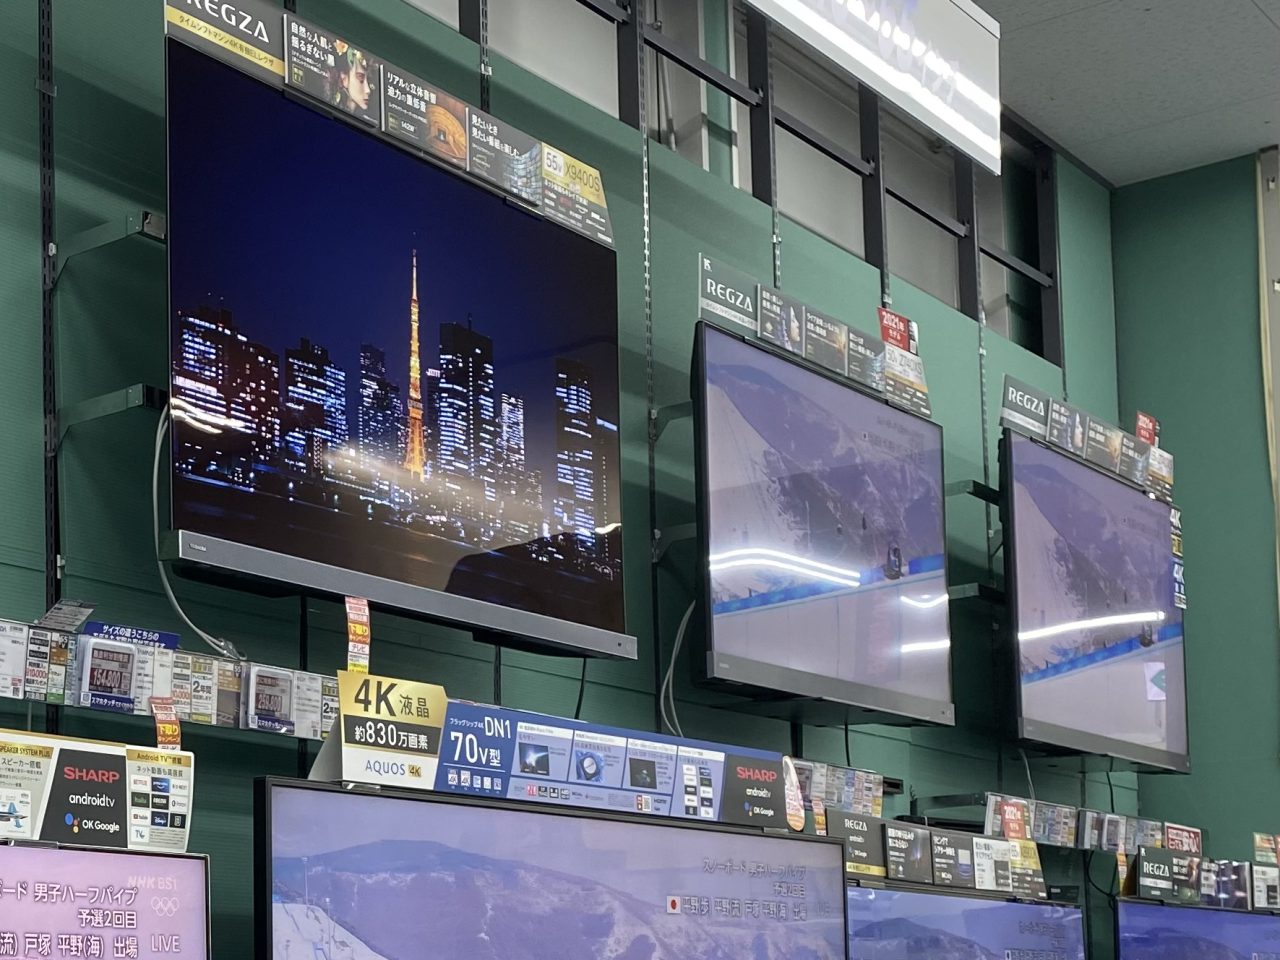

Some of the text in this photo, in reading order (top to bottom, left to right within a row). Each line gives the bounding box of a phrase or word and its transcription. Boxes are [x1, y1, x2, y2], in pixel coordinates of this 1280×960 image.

[291, 22, 333, 51] 自然な人肌と
[472, 114, 498, 136] 見たいとき
[706, 278, 753, 313] REGZA
[882, 311, 905, 333] 2021年
[1008, 386, 1045, 417] REGZA
[103, 625, 160, 641] サイズの違うこちらの
[351, 645, 367, 653] テレビ
[93, 669, 120, 686] 154,800
[192, 680, 212, 695] 2年間
[354, 679, 430, 718] 4K液晶
[354, 721, 429, 750] 約830万画素
[484, 716, 511, 739] DN1
[19, 747, 38, 756] SYSTEM
[137, 753, 158, 762] Android
[450, 731, 501, 767] 70V型
[63, 766, 120, 784] SHARP
[365, 760, 421, 776] AQUOS 4K
[736, 766, 778, 782] SHARP
[82, 819, 120, 833] OK Google
[844, 818, 868, 832] REGZA
[1144, 861, 1169, 877] REGZA
[127, 876, 156, 889] NHK
[34, 882, 138, 906] 男子ハーフパイプ
[77, 908, 138, 929] 予選2回目
[24, 932, 52, 956] 戸塚
[57, 933, 104, 959] 平野(海)
[113, 936, 139, 959] 出場
[151, 935, 181, 953] LIVE
